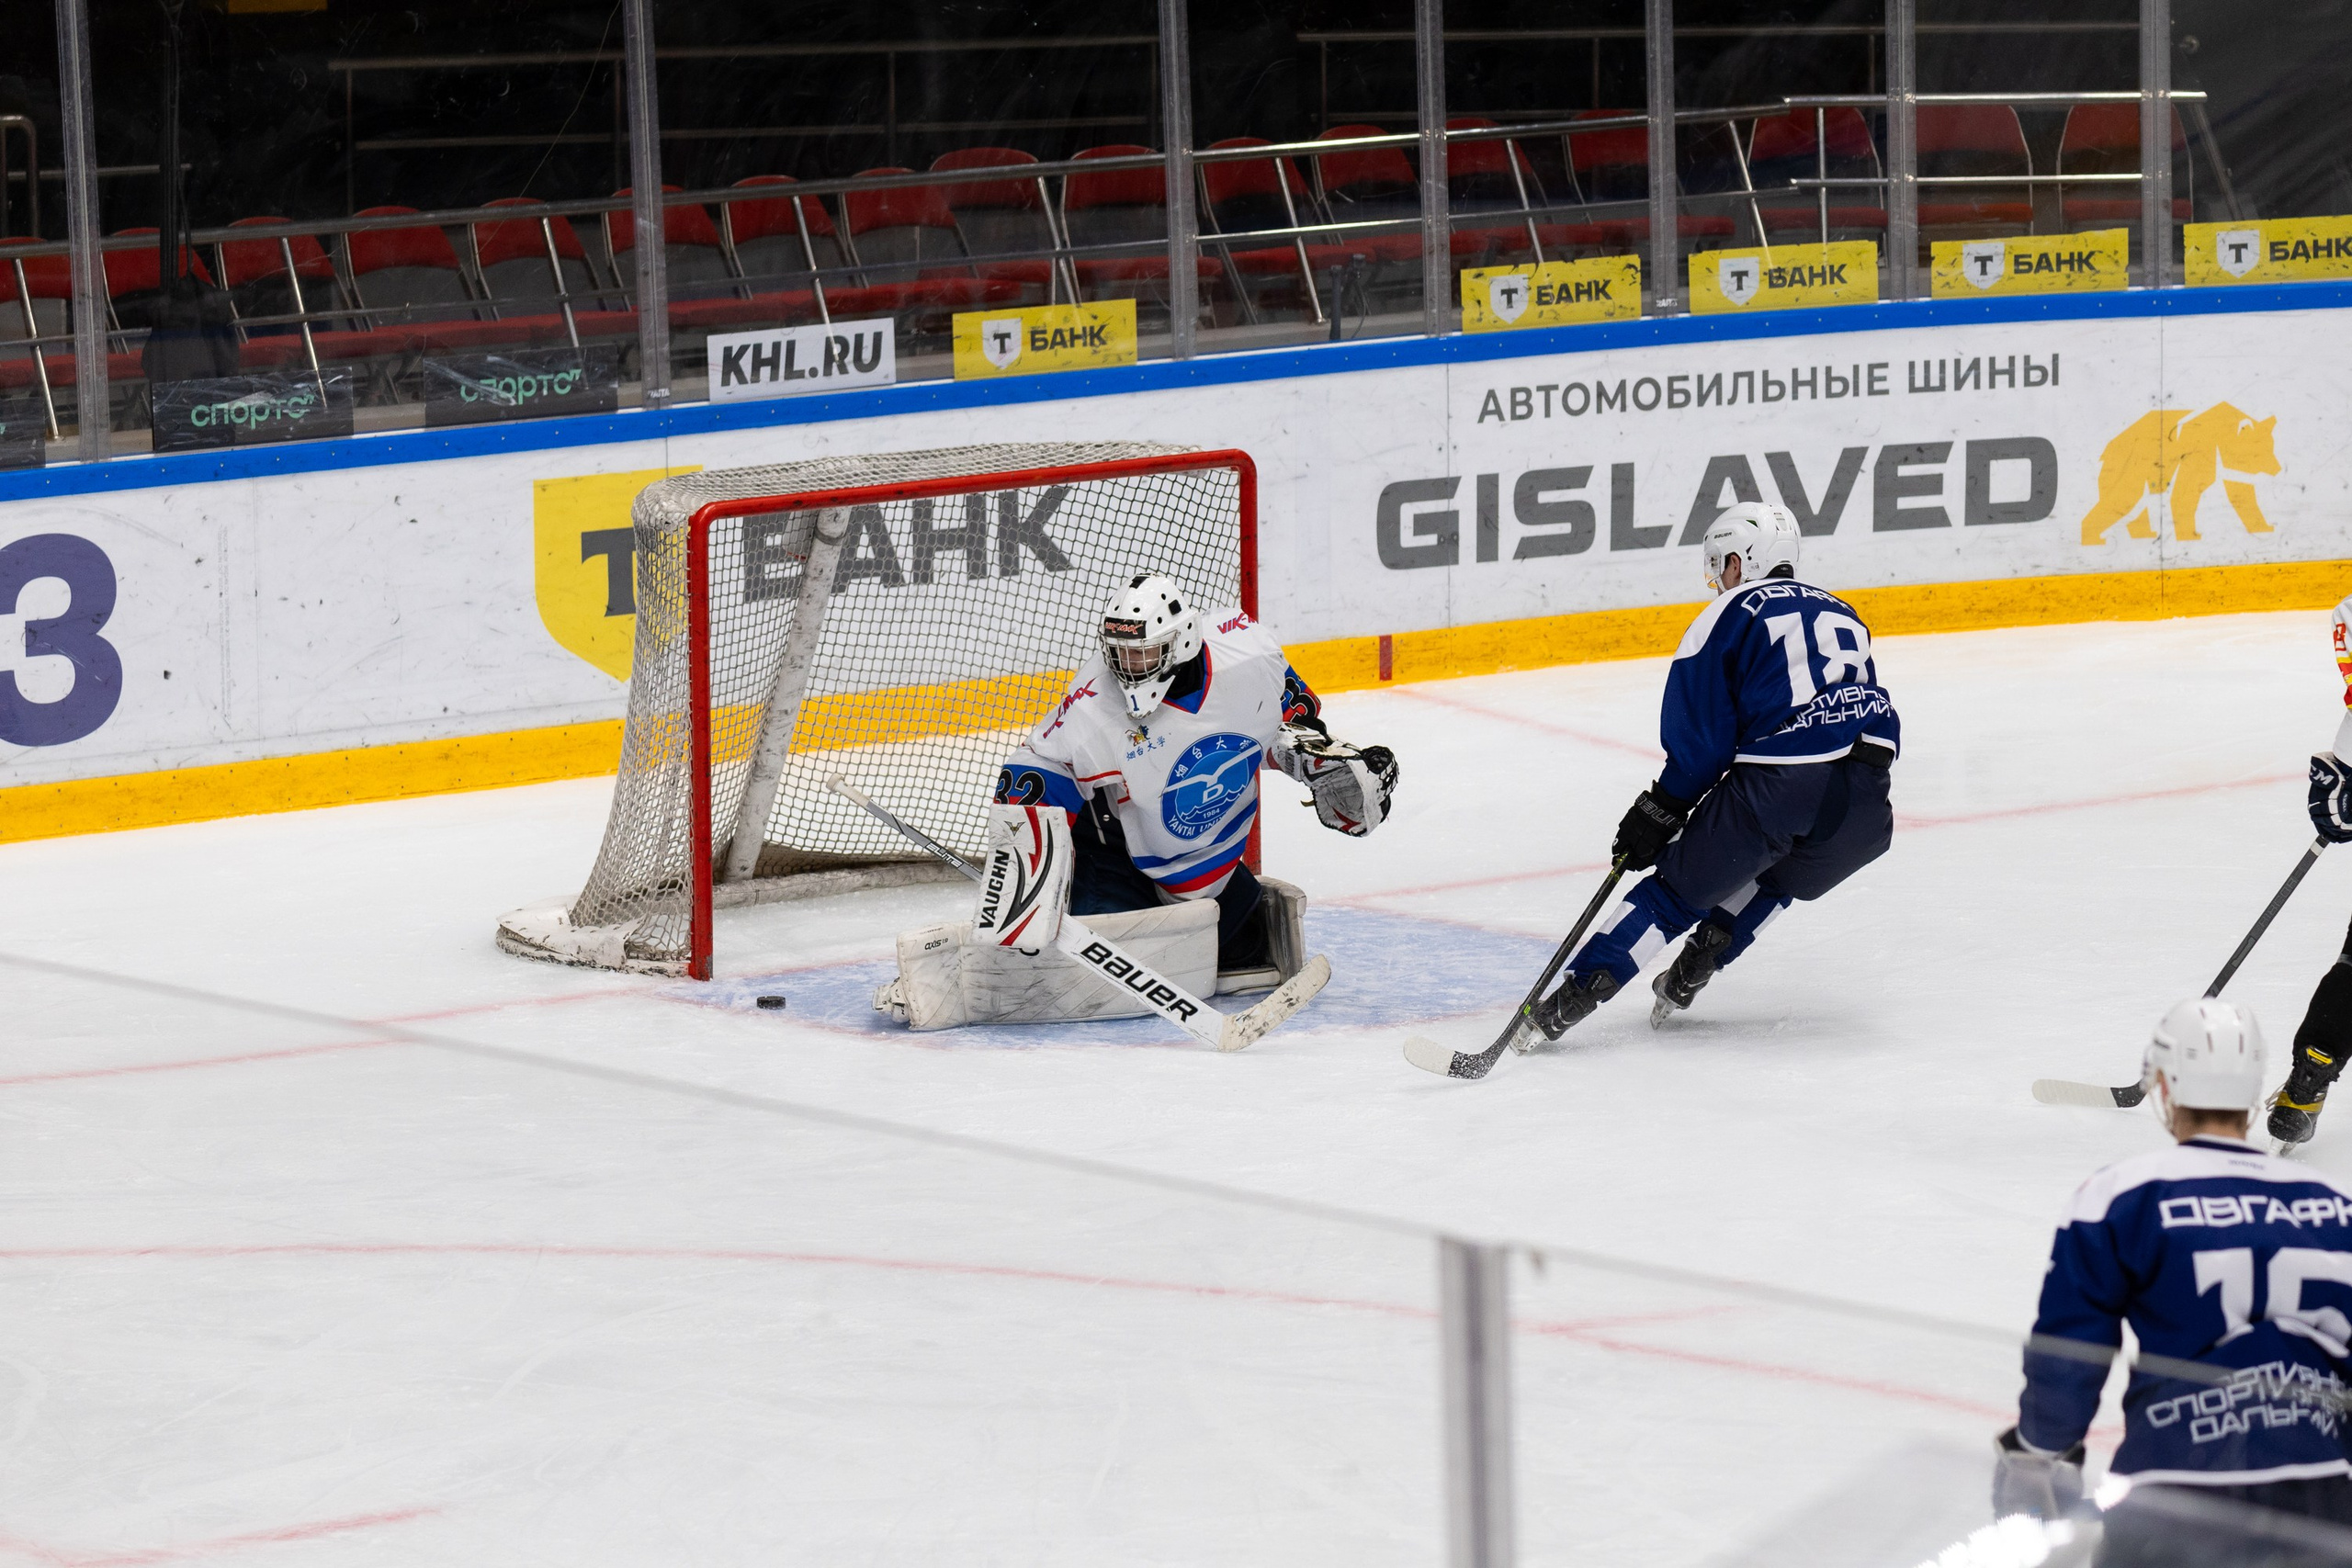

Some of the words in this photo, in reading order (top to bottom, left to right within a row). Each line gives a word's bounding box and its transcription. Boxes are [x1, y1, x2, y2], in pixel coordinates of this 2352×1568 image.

[2013, 251, 2097, 275] БАНК
[2269, 237, 2352, 262] БАНК
[1768, 264, 1848, 289] БАНК
[1535, 279, 1612, 306] БАНК
[1030, 324, 1108, 351] БАНК
[721, 332, 883, 387] KHL.RU
[1477, 362, 1890, 424] АВТОМОБИЛЬНЫЕ
[1907, 353, 2060, 394] ШИНЫ
[1376, 436, 2058, 570] GISLAVED
[1764, 611, 1871, 706] 18
[1168, 815, 1196, 837] YANTAI
[978, 850, 1011, 929] VAUGHN
